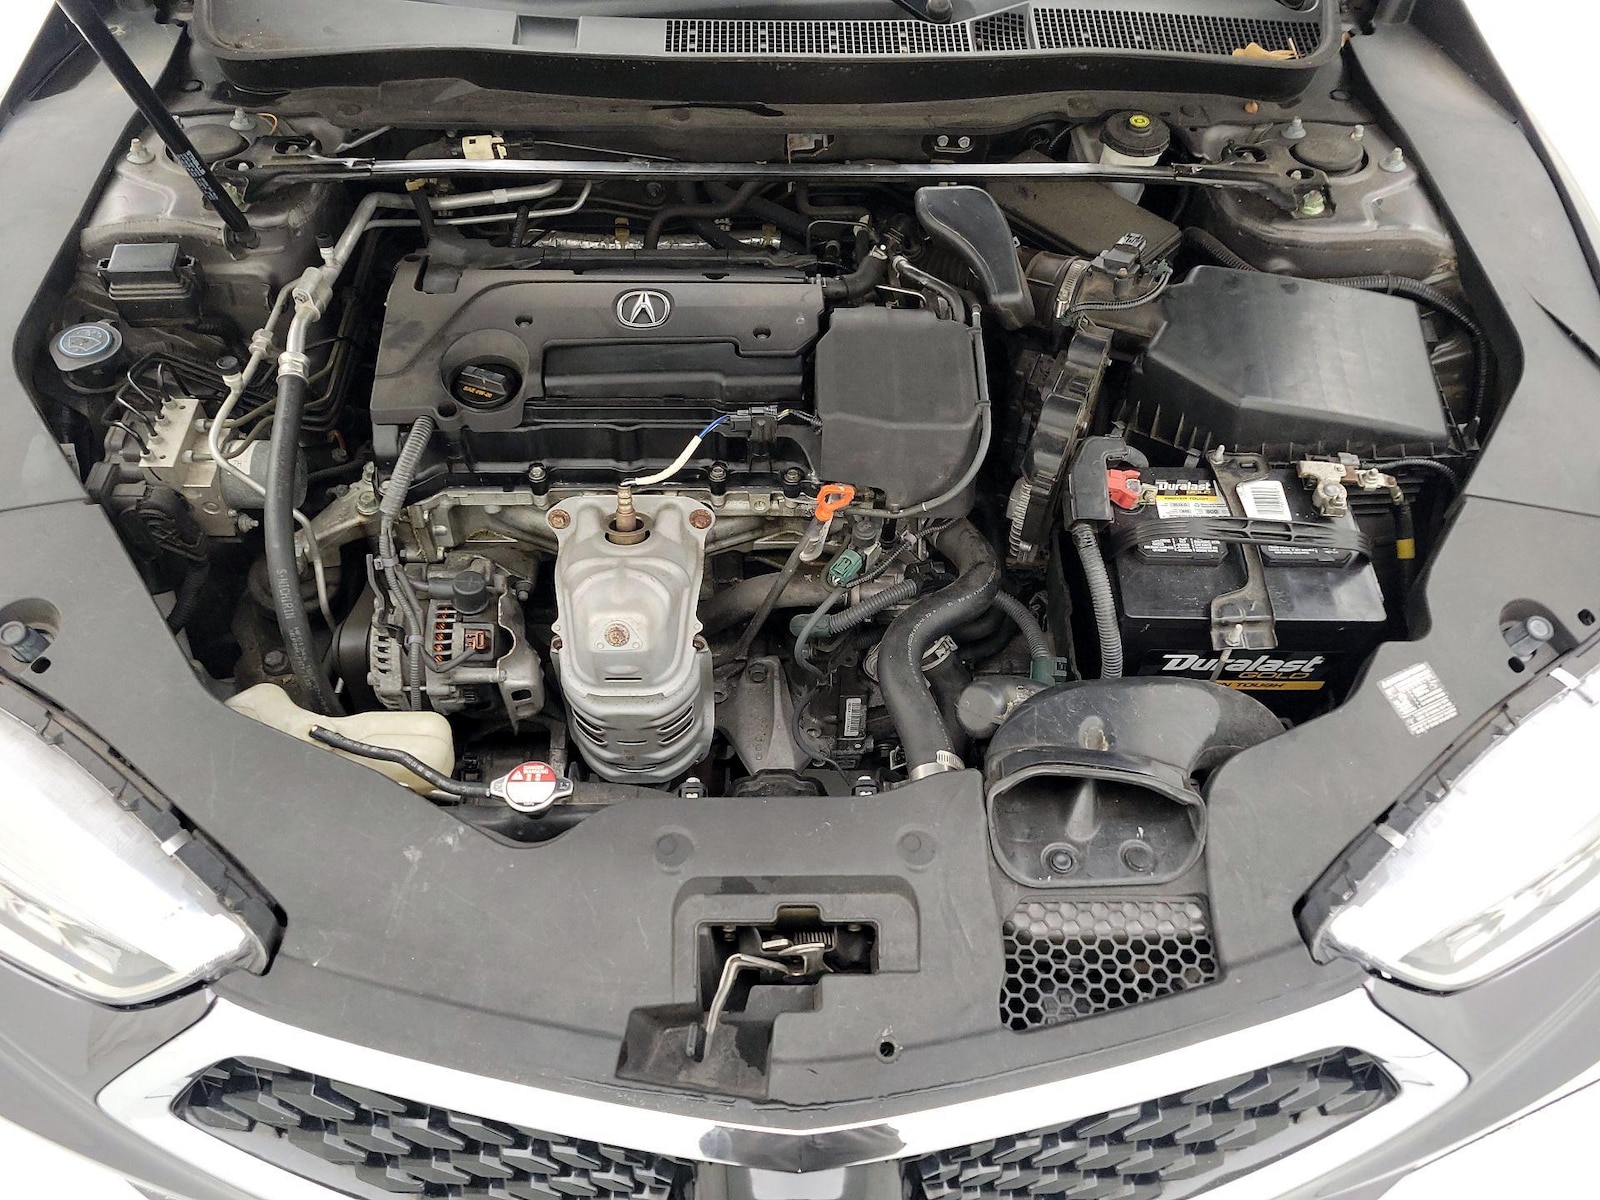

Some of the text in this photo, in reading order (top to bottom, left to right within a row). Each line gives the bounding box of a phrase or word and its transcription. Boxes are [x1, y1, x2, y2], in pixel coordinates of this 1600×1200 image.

[1155, 481, 1211, 491] Duralast
[1162, 654, 1326, 673] Duralast
[1238, 671, 1311, 680] GOLD
